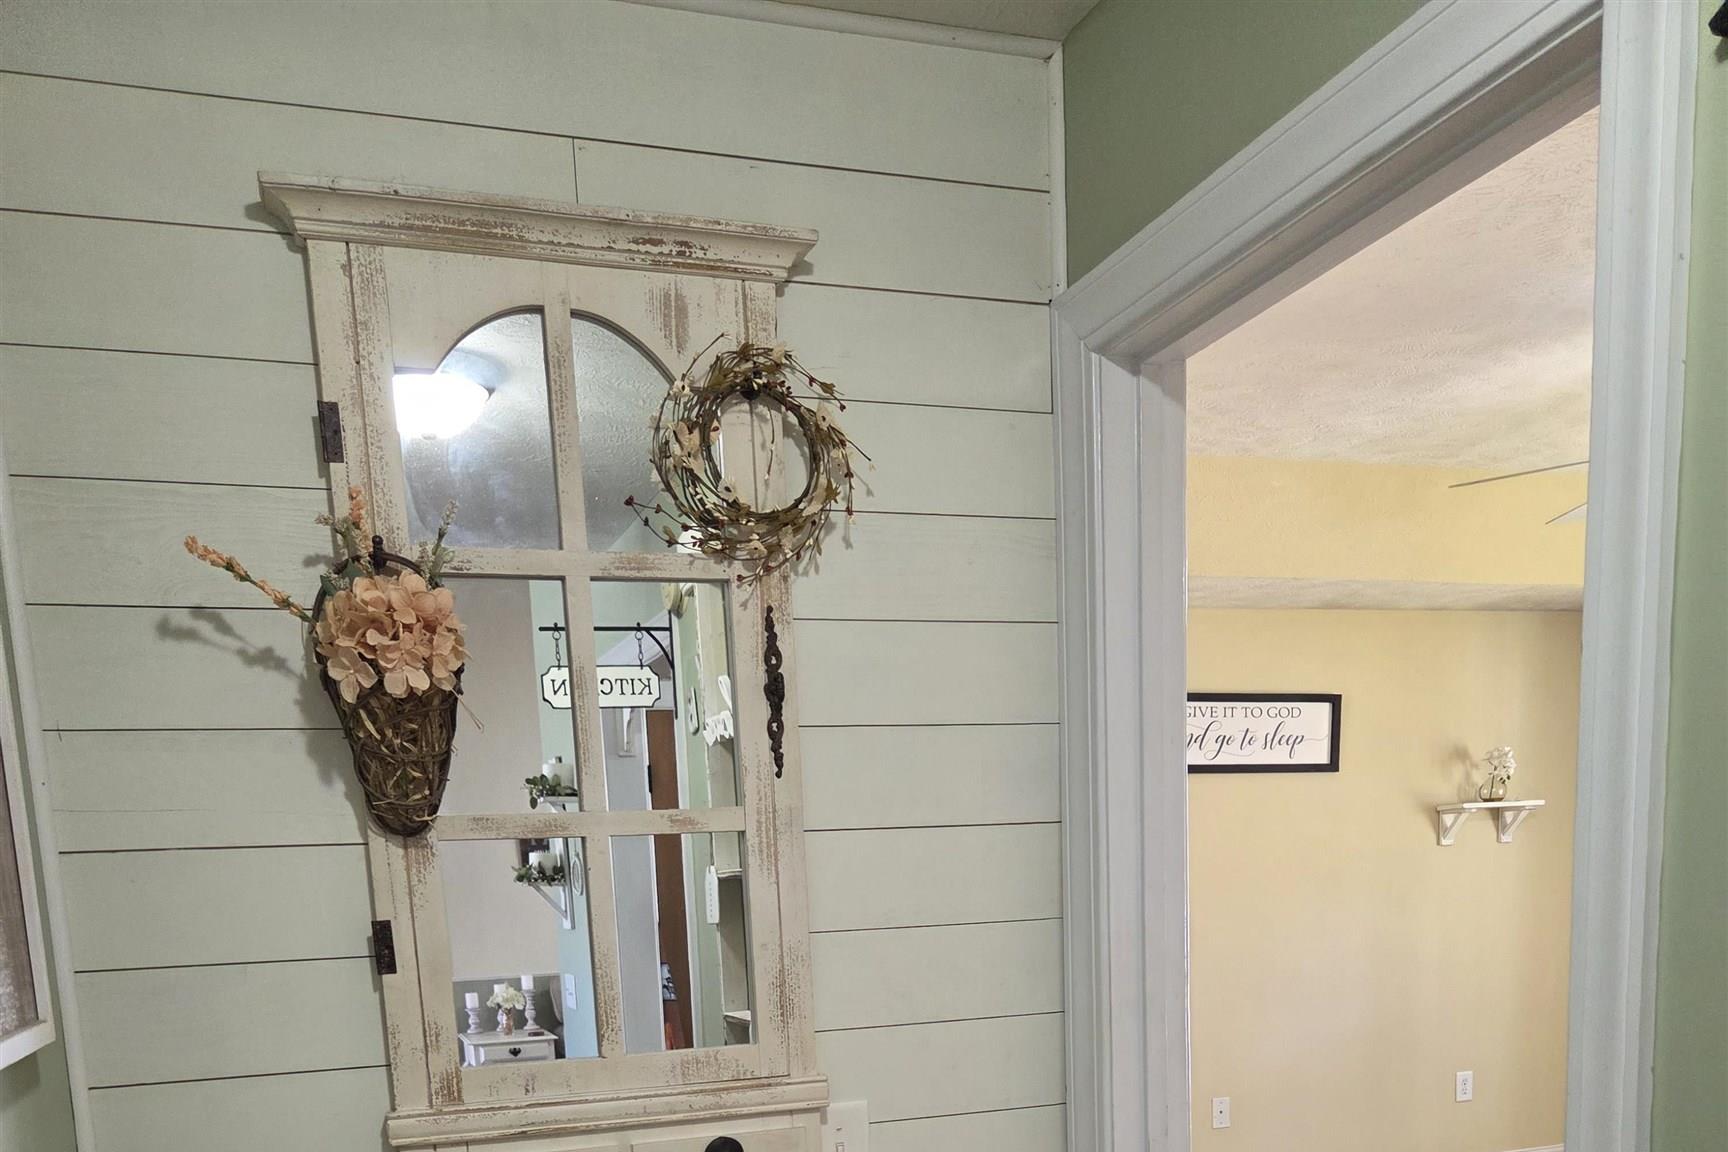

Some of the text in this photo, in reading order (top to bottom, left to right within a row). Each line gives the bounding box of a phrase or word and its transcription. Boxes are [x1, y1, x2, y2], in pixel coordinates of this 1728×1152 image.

[1223, 706, 1239, 718] IT
[1241, 706, 1263, 719] TO
[1266, 706, 1302, 719] GOD
[1204, 732, 1236, 760] go
[1238, 728, 1258, 751] to
[1262, 720, 1305, 759] sleep
